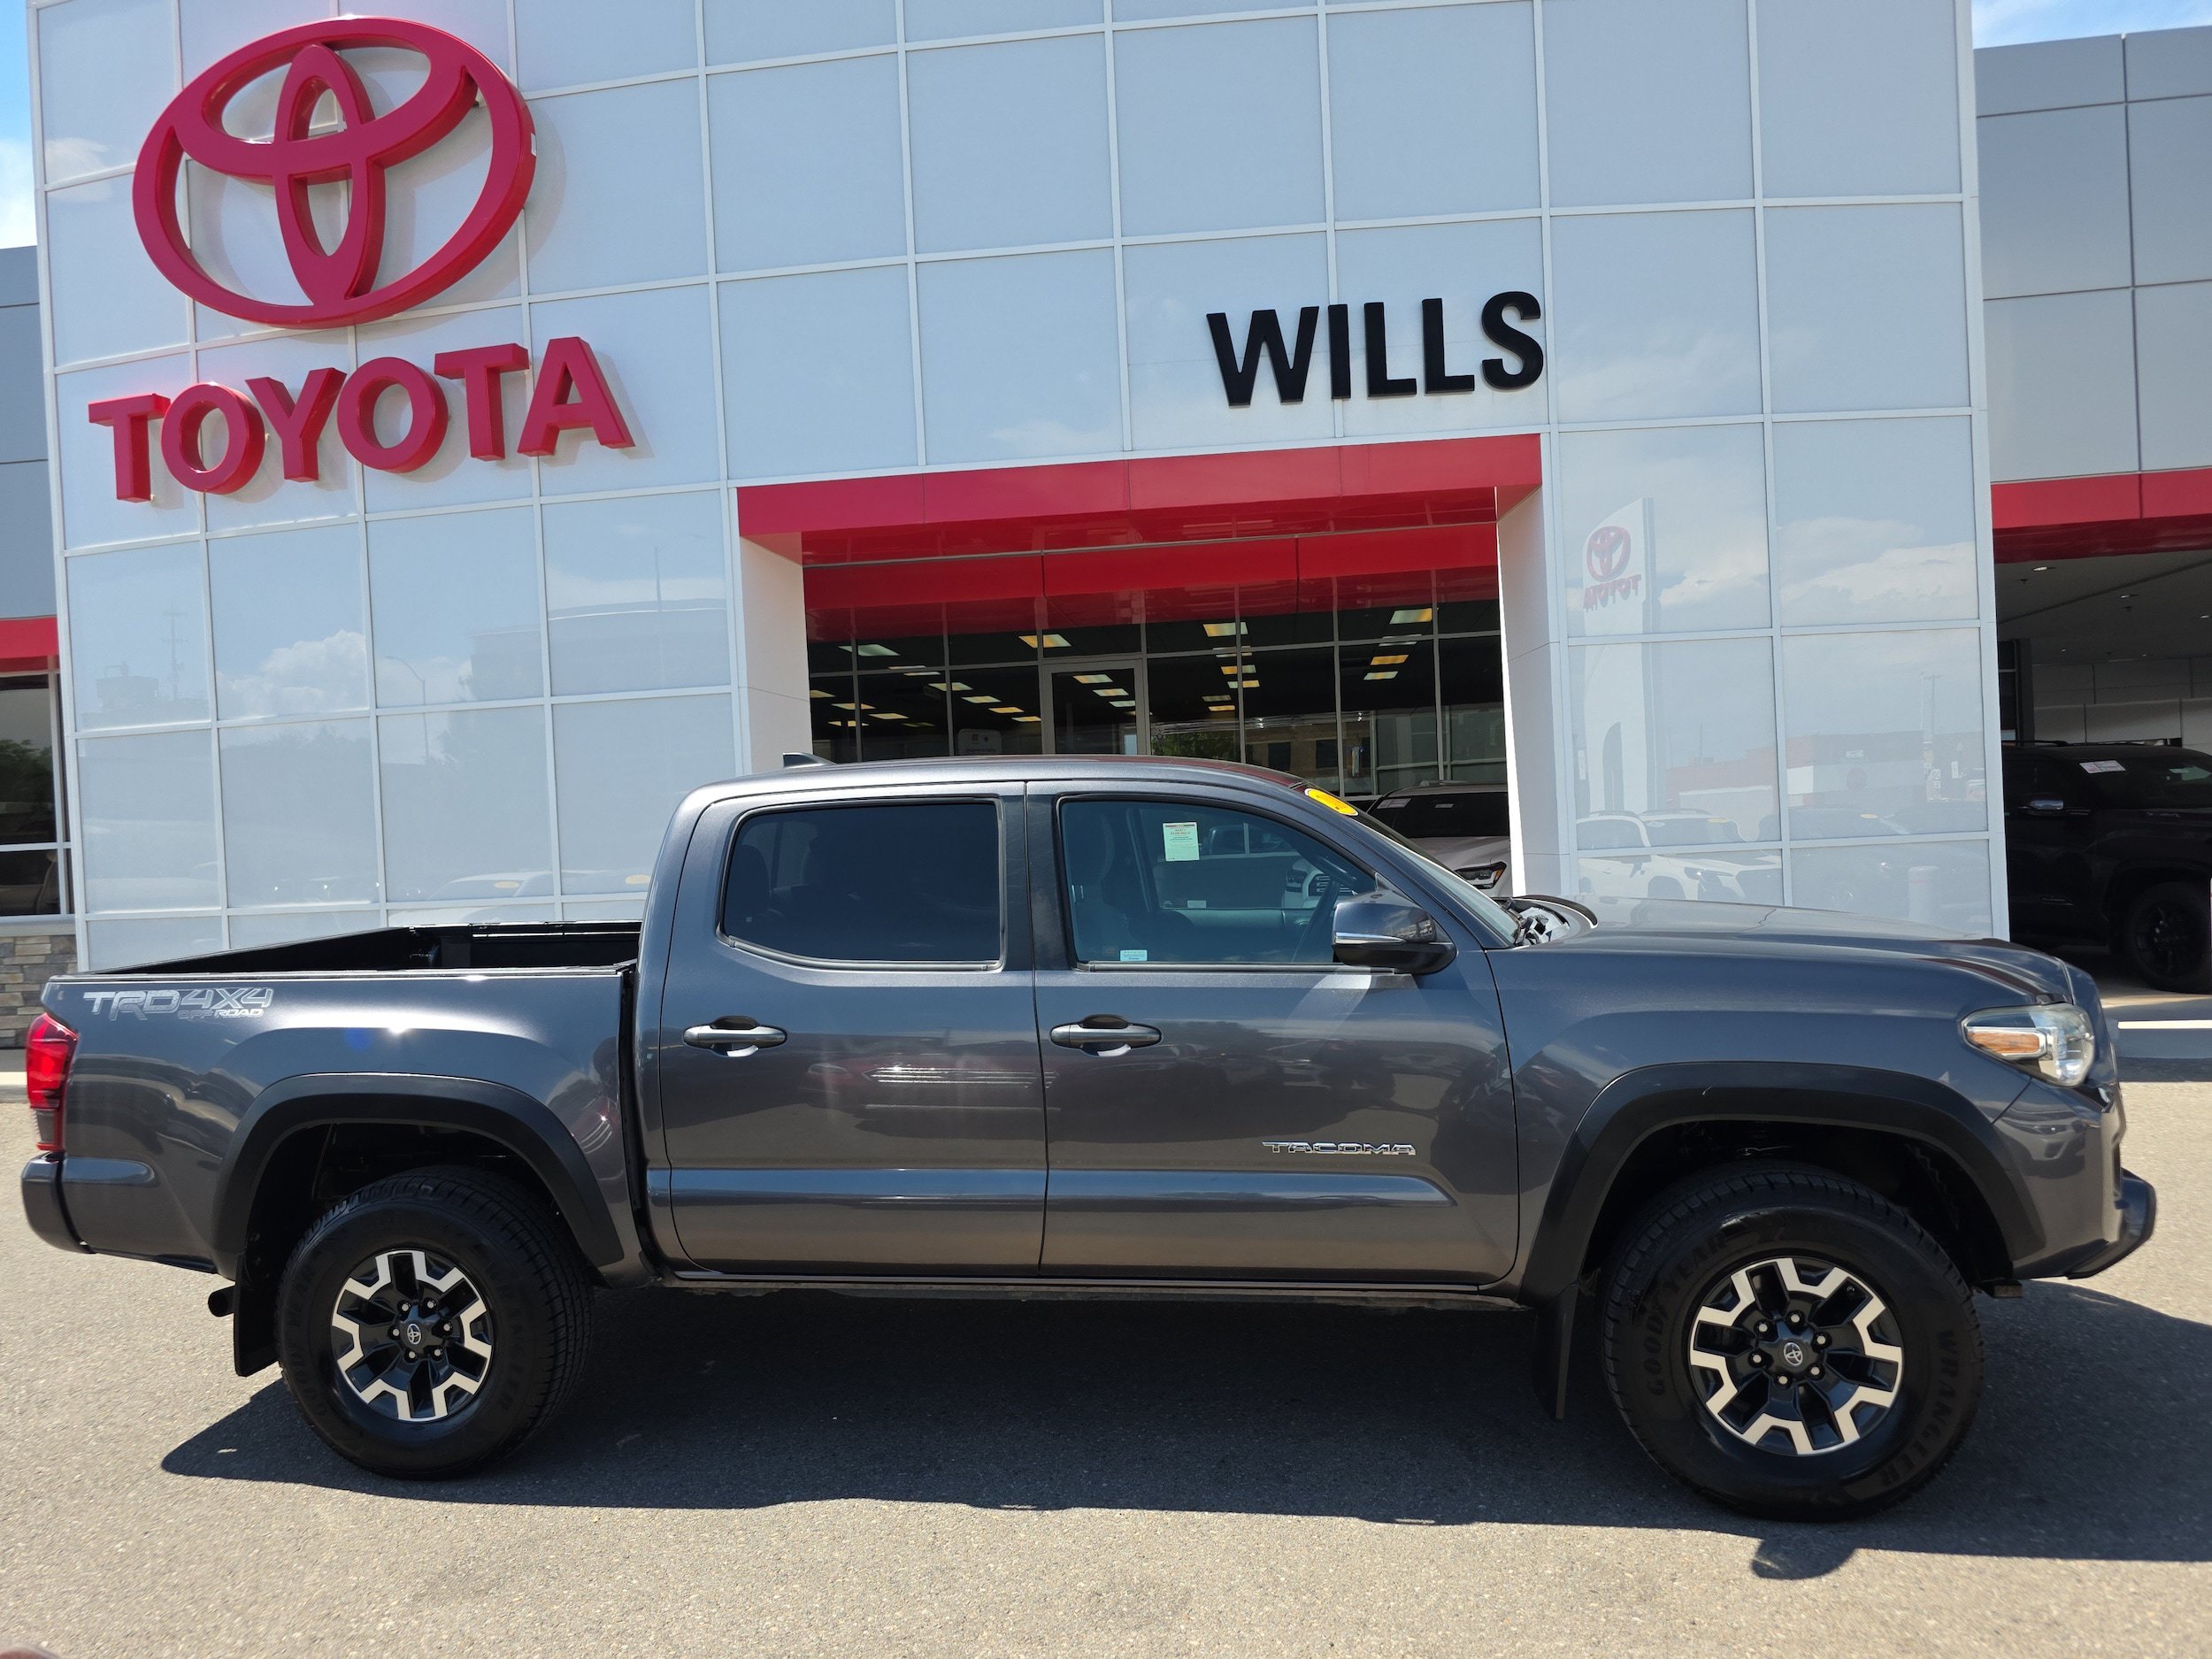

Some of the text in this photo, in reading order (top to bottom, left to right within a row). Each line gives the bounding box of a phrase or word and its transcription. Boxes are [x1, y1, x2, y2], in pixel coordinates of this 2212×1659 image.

[1206, 290, 1544, 407] WILLS
[88, 336, 635, 503] TOYOTA
[83, 989, 180, 1020] TRD
[213, 1007, 264, 1018] ROAD
[1262, 1141, 1417, 1156] TACOMA
[1880, 1329, 1959, 1487] WRANGLER
